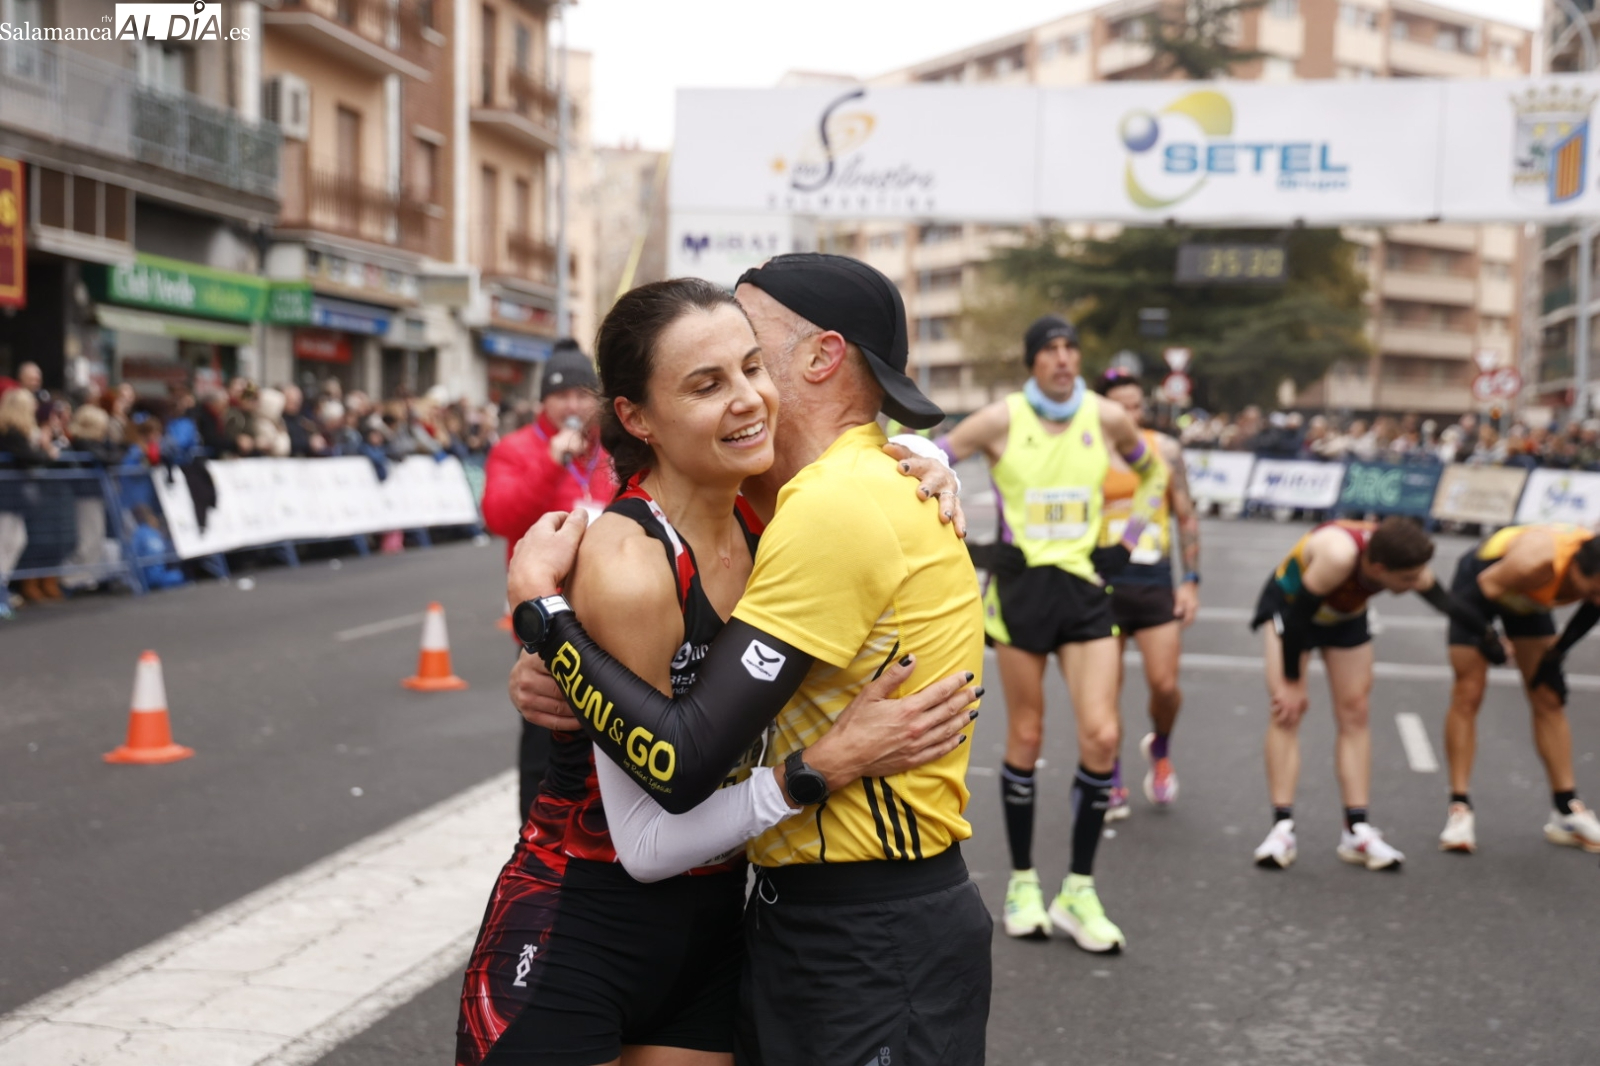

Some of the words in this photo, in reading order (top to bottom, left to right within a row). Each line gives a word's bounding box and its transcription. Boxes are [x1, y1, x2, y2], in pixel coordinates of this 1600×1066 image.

[1163, 142, 1348, 174] SETEL
[551, 641, 614, 732] RUN
[608, 717, 624, 746] &
[626, 726, 676, 782] GO
